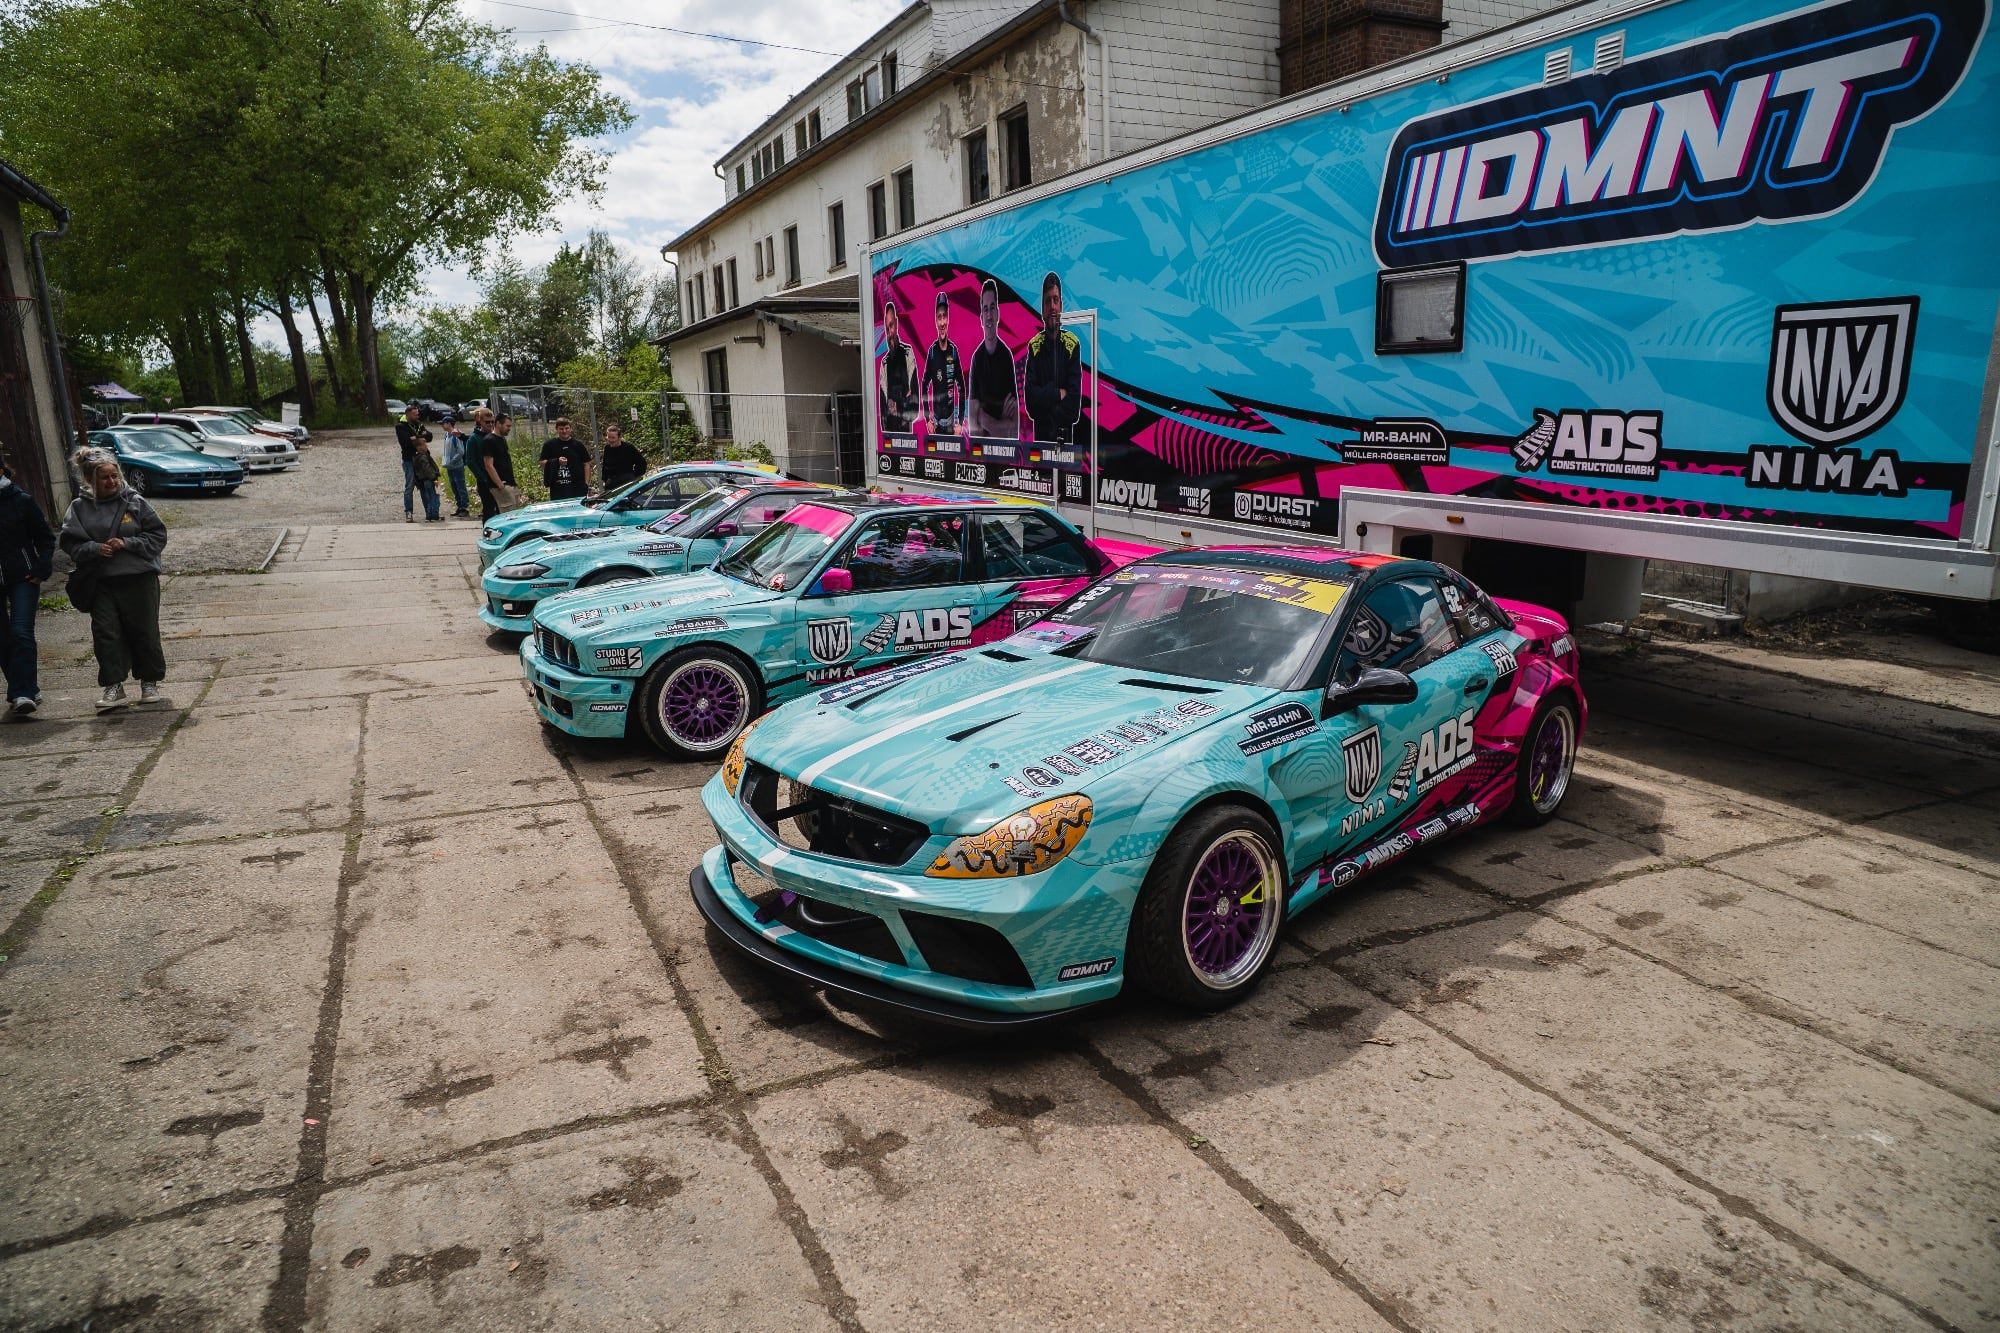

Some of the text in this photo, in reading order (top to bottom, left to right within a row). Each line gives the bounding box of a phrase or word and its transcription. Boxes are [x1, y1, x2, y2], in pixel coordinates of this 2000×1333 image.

[1552, 414, 1658, 462] ADS
[1551, 459, 1655, 477] CONSTRUCTION GMBH
[1751, 450, 1900, 490] NIMA
[1099, 478, 1158, 508] MOTUL
[1178, 486, 1200, 497] STUDIO
[1187, 498, 1200, 508] ONE
[1252, 493, 1315, 517] DURST
[895, 607, 972, 644] ADS
[596, 648, 625, 659] STUDIO
[894, 638, 972, 653] CONSTRUCTION GMBH
[1484, 641, 1510, 660] 59N
[610, 657, 627, 666] ONE
[806, 665, 855, 681] NIMA
[1415, 707, 1473, 782] ADS
[1417, 761, 1460, 795] CONSTRUCTION
[1341, 798, 1385, 837] NIMA
[1446, 807, 1468, 822] STUDIO
[1066, 961, 1114, 978] DMNT
